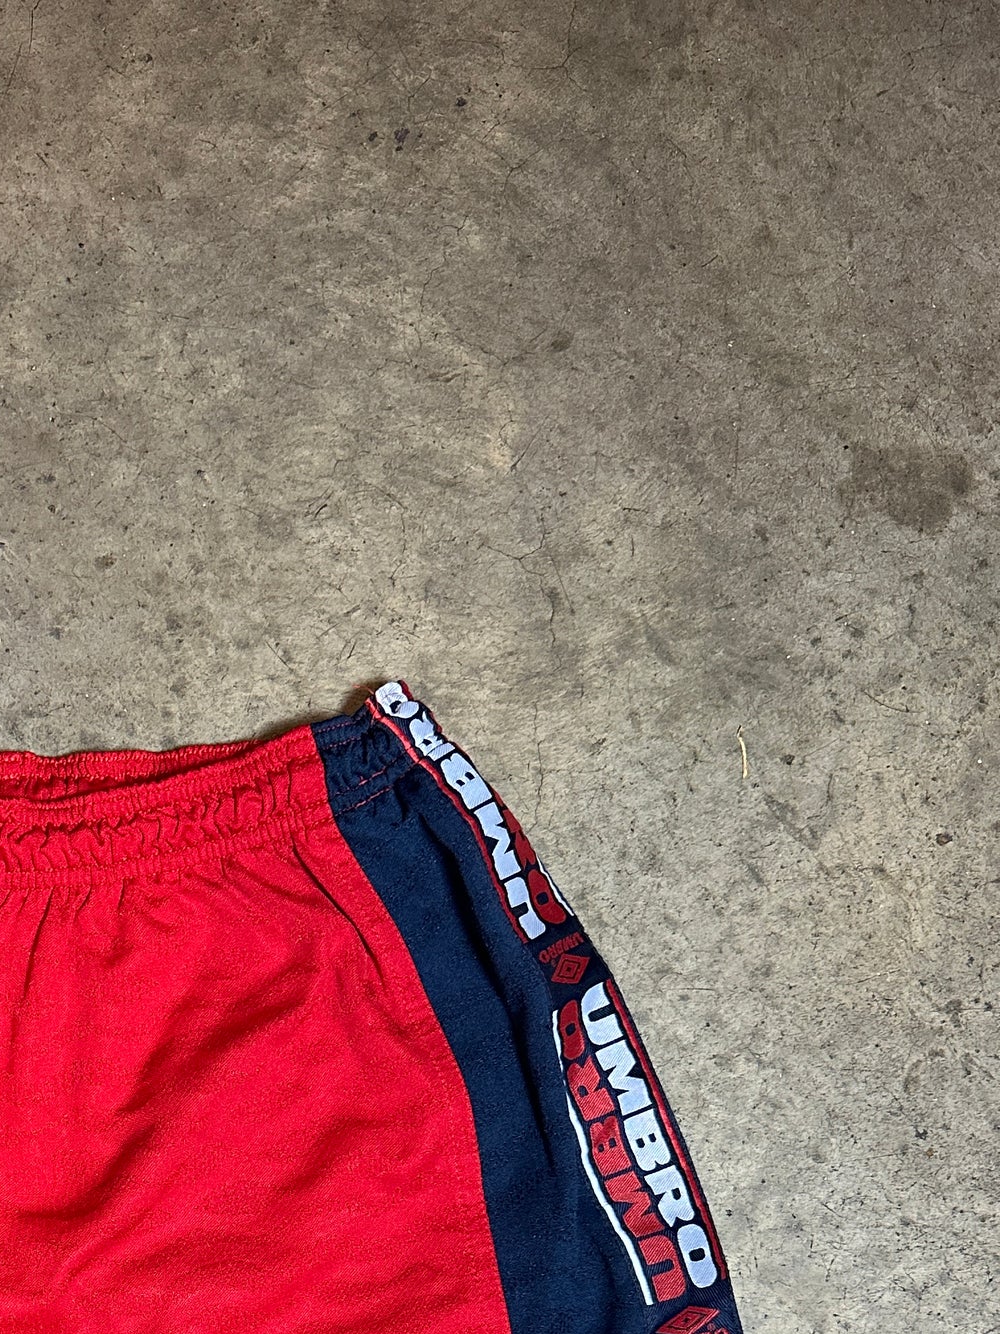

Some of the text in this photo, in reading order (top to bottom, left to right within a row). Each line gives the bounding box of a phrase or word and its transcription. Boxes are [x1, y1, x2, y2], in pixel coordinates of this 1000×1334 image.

[375, 682, 546, 940] UMBRO
[558, 1000, 687, 1303] UMBRO
[581, 981, 717, 1289] UMBRO
